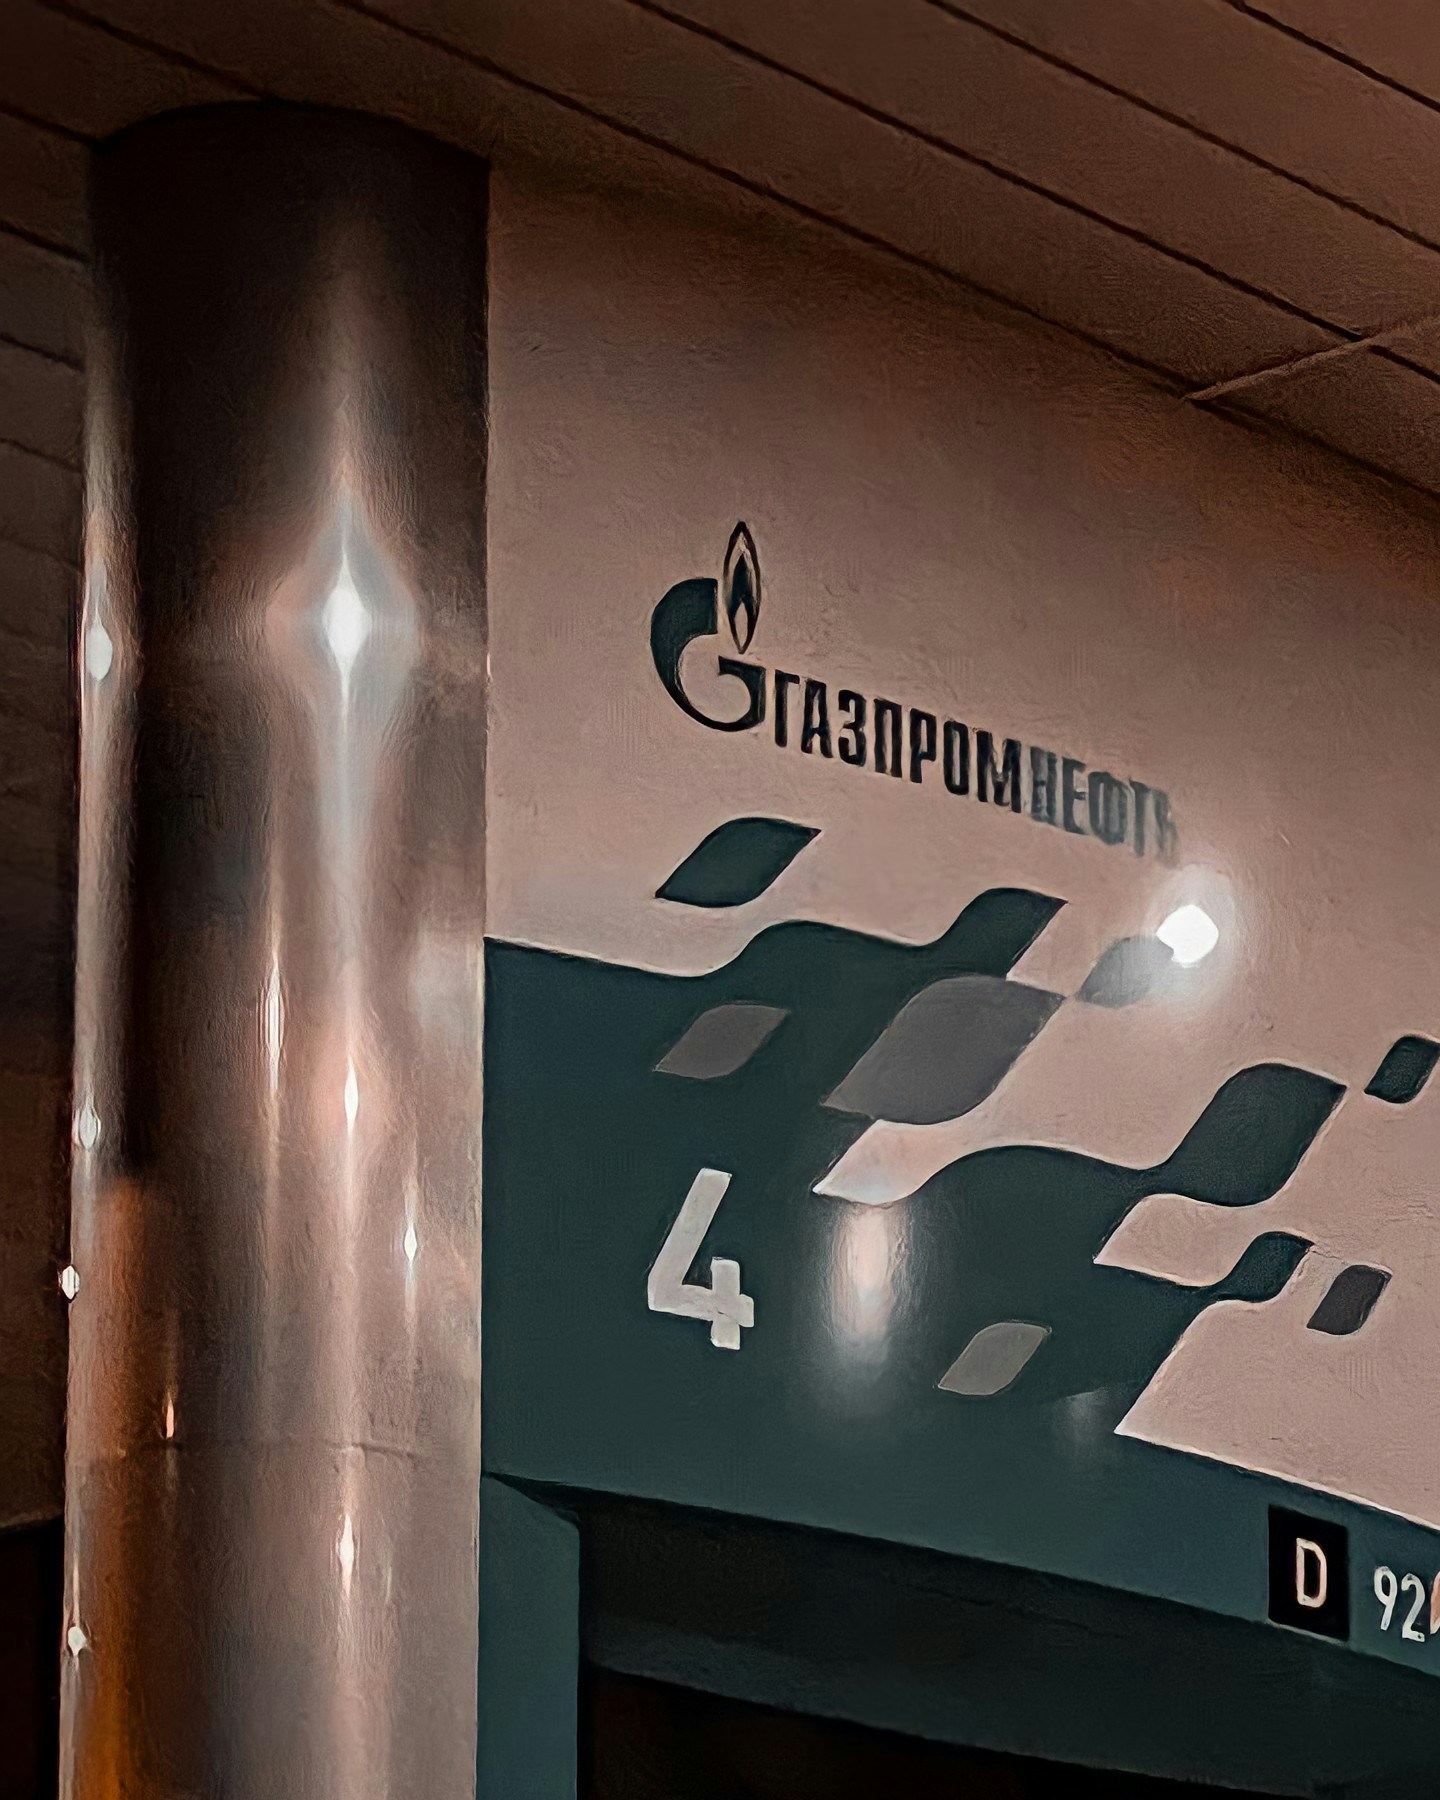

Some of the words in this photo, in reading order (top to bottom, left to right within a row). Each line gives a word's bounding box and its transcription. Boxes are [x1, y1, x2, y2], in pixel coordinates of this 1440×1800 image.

[648, 1167, 754, 1350] 4
[1296, 1537, 1327, 1609] D
[1374, 1566, 1426, 1643] 92
